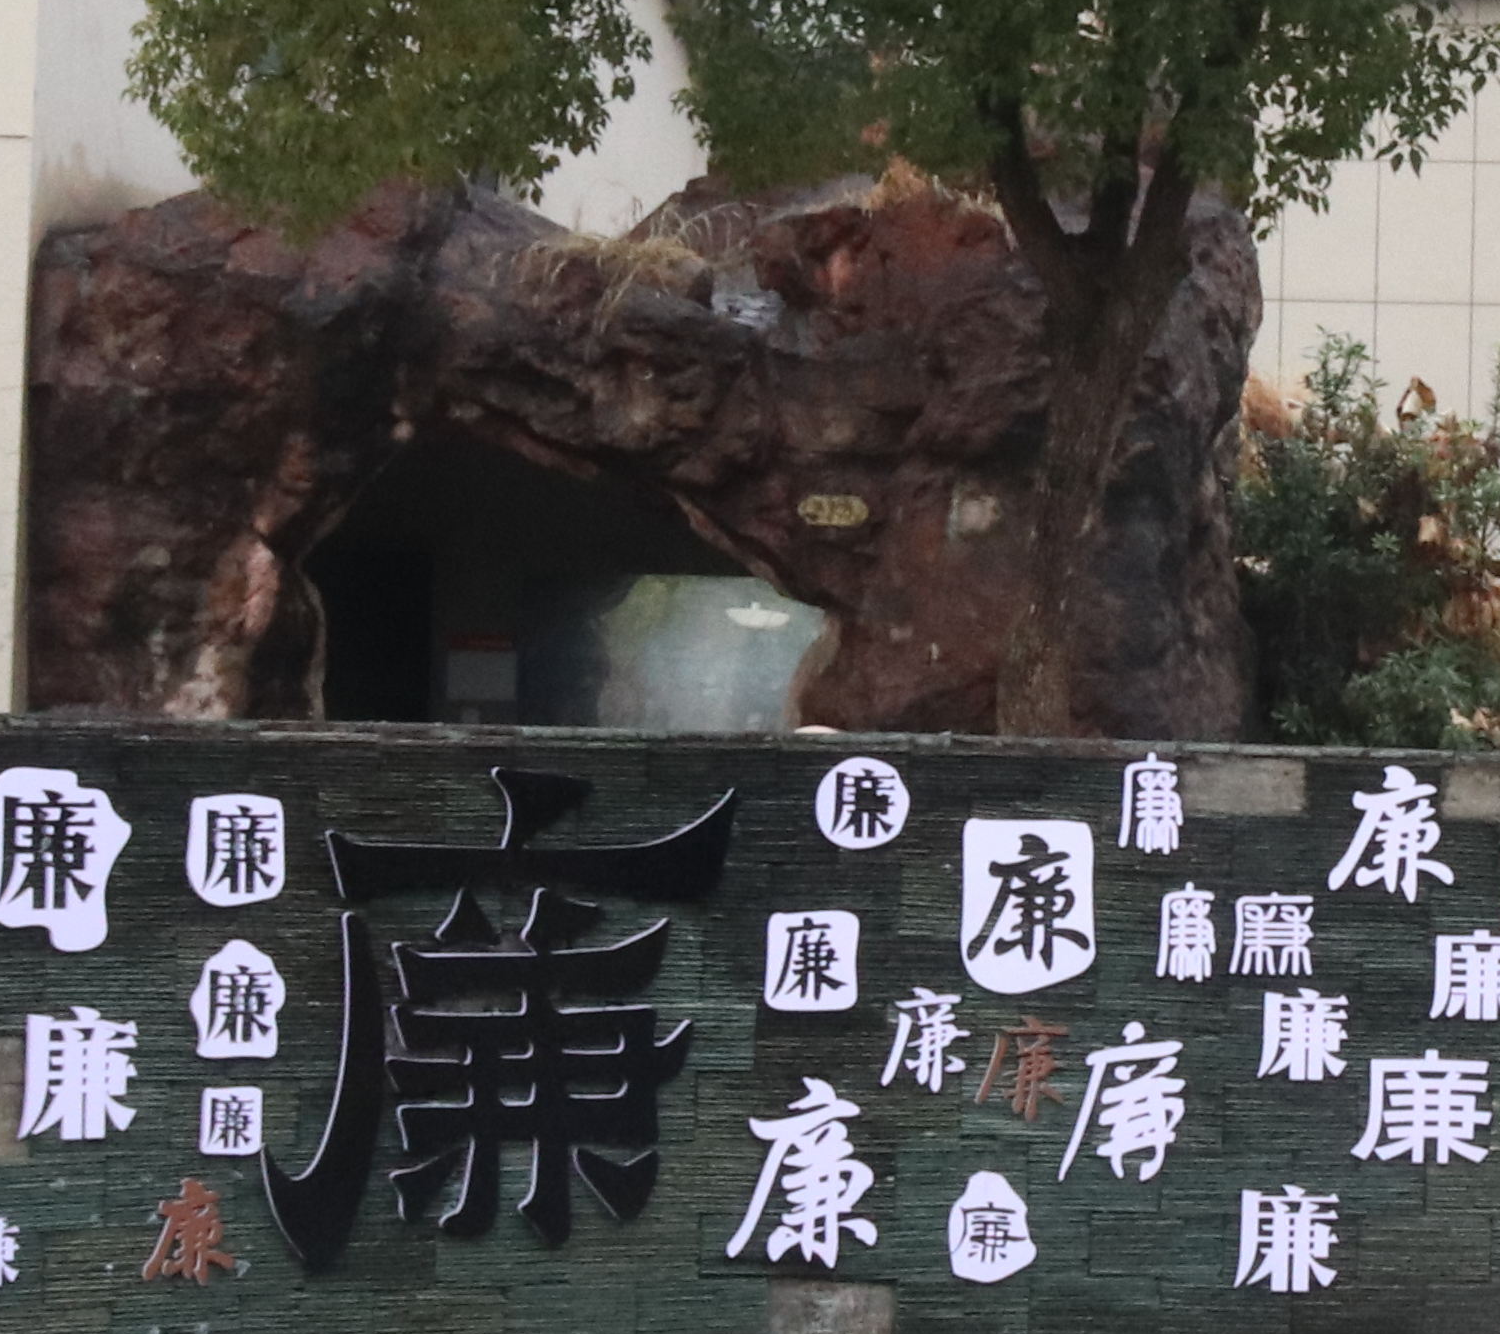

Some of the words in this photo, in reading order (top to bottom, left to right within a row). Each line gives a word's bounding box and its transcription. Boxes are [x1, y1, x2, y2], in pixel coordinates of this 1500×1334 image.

[203, 805, 276, 894] 廉
[832, 768, 895, 838] 廉
[1328, 765, 1455, 904] 廉
[967, 834, 1090, 970] 廉
[207, 966, 272, 1043] 廉
[771, 918, 847, 1001] 廉
[261, 766, 736, 1269] 廉
[881, 987, 971, 1093] 廉
[975, 1016, 1069, 1122] 廉
[1257, 987, 1349, 1081] 廉
[18, 1006, 138, 1141] 廉
[208, 1096, 253, 1148] 廉
[1351, 1049, 1492, 1164] 廉
[726, 1076, 878, 1269] 廉
[952, 1203, 1027, 1263] 廉
[1234, 1184, 1340, 1292] 廉
